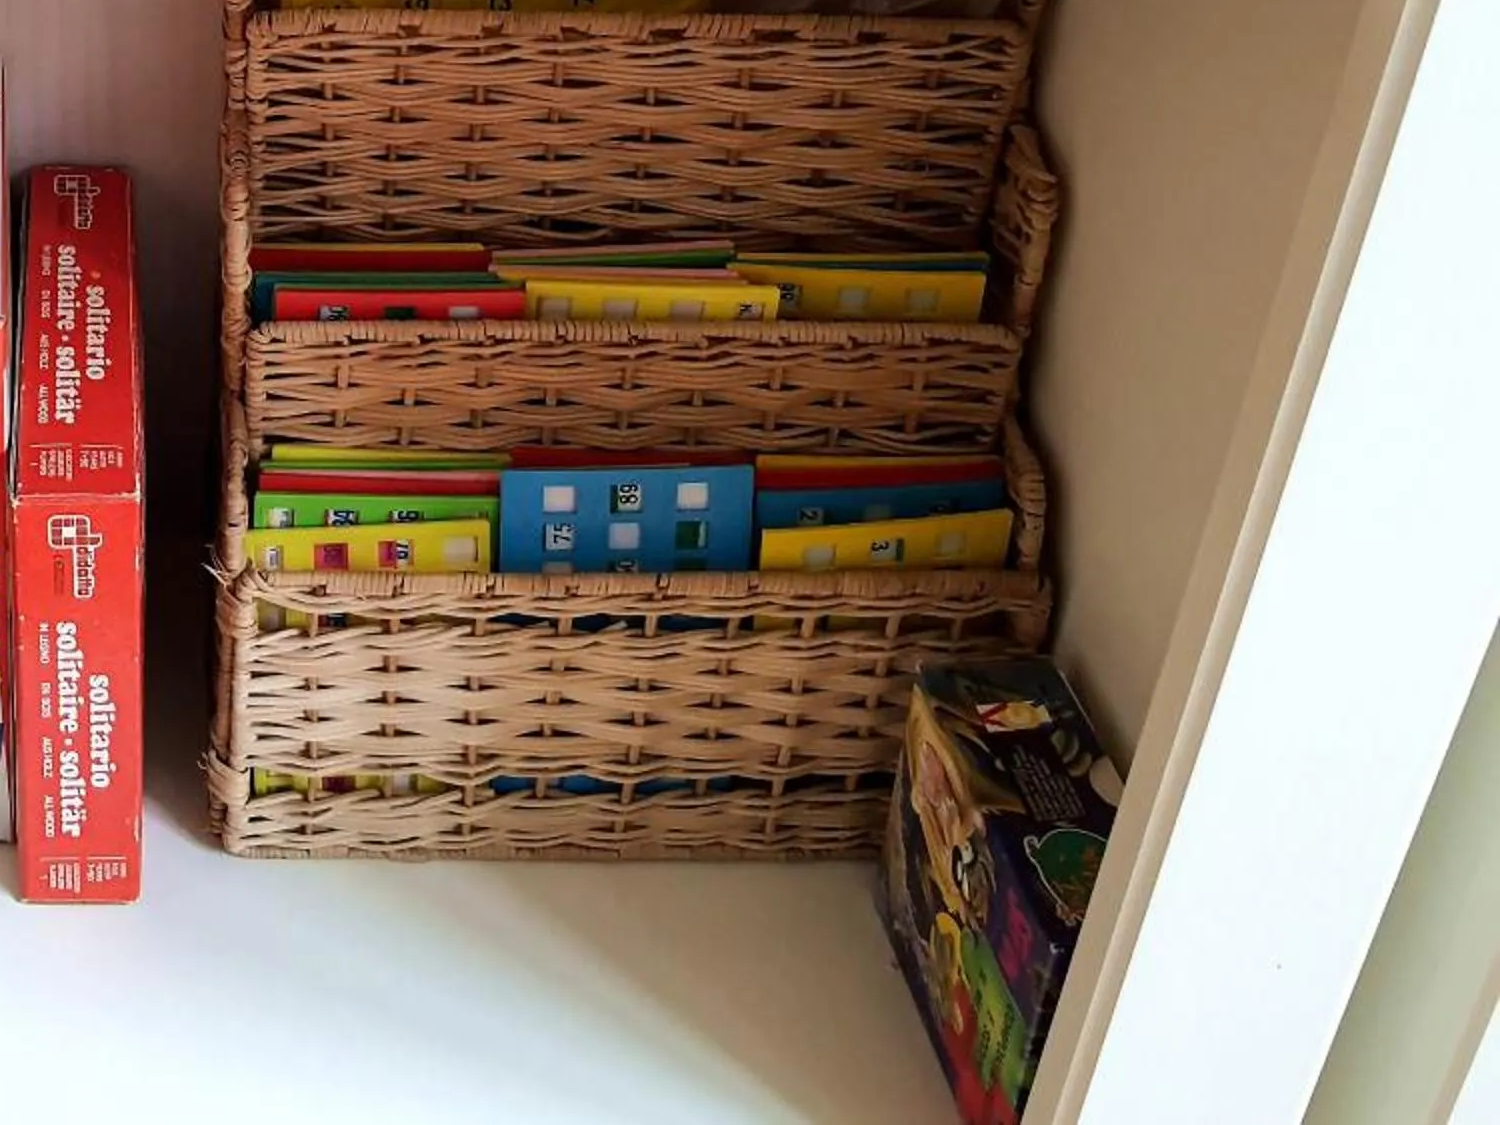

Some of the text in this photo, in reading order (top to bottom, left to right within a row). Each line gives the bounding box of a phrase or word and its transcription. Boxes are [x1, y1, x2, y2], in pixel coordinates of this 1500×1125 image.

[56, 245, 82, 330] solitaire
[84, 284, 112, 380] solitario
[54, 346, 83, 424] solitär
[618, 483, 639, 505] 89
[56, 621, 87, 737] solitaire
[89, 674, 116, 788] solitario
[59, 750, 88, 837] solitär
